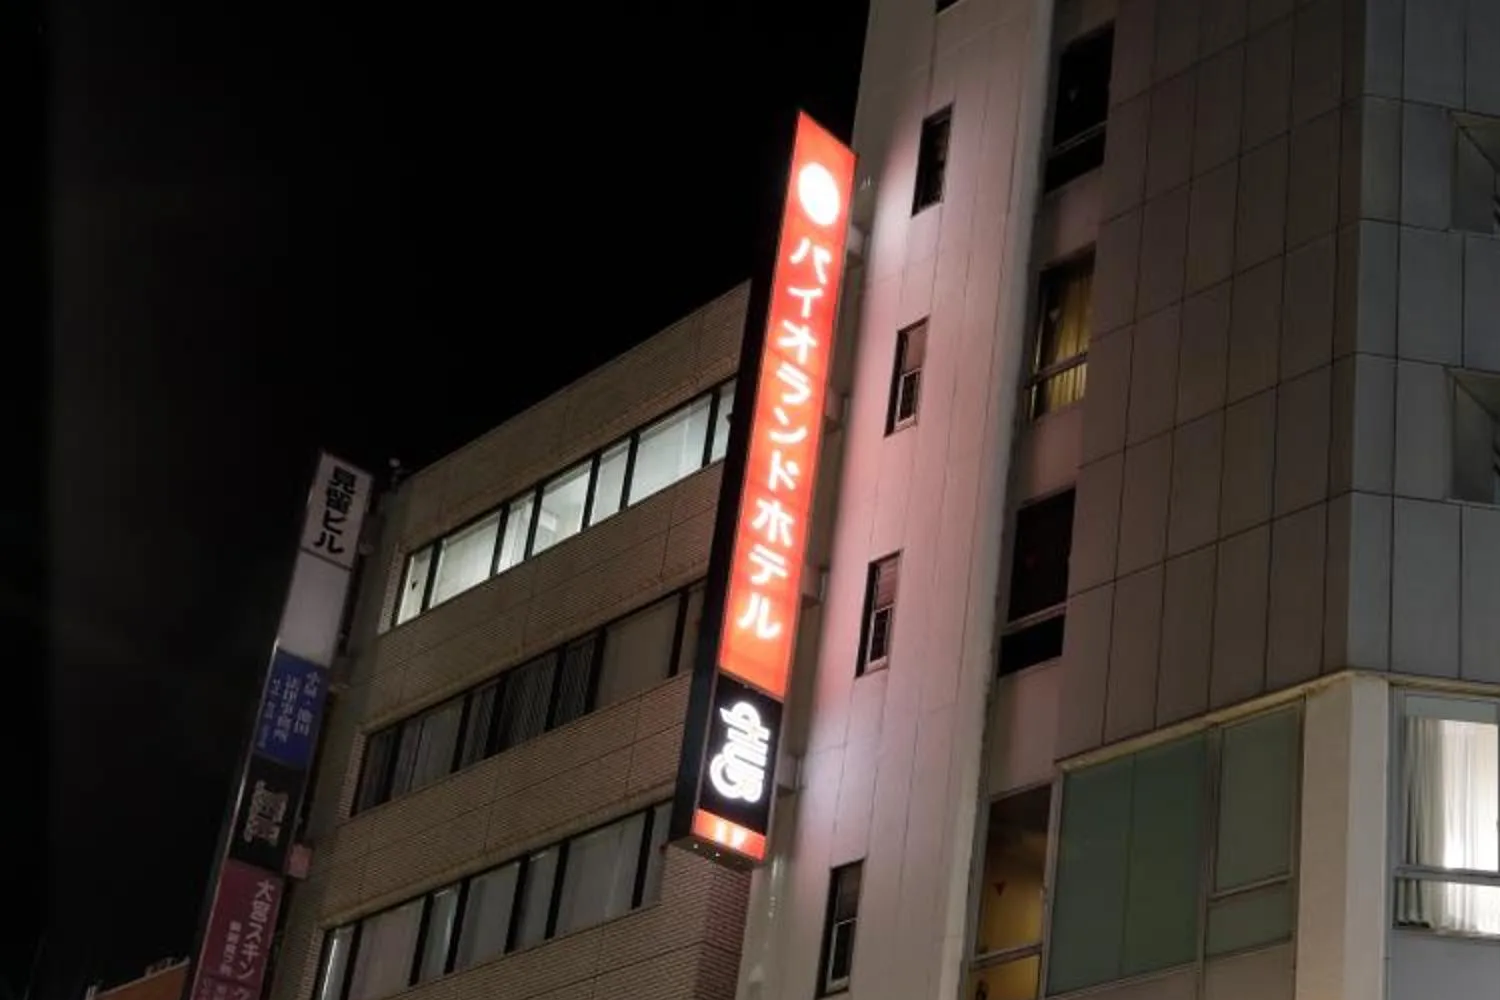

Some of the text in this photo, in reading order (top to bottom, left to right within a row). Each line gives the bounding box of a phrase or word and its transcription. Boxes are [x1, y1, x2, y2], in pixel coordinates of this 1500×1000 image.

[739, 237, 831, 641] パイオランドホテル
